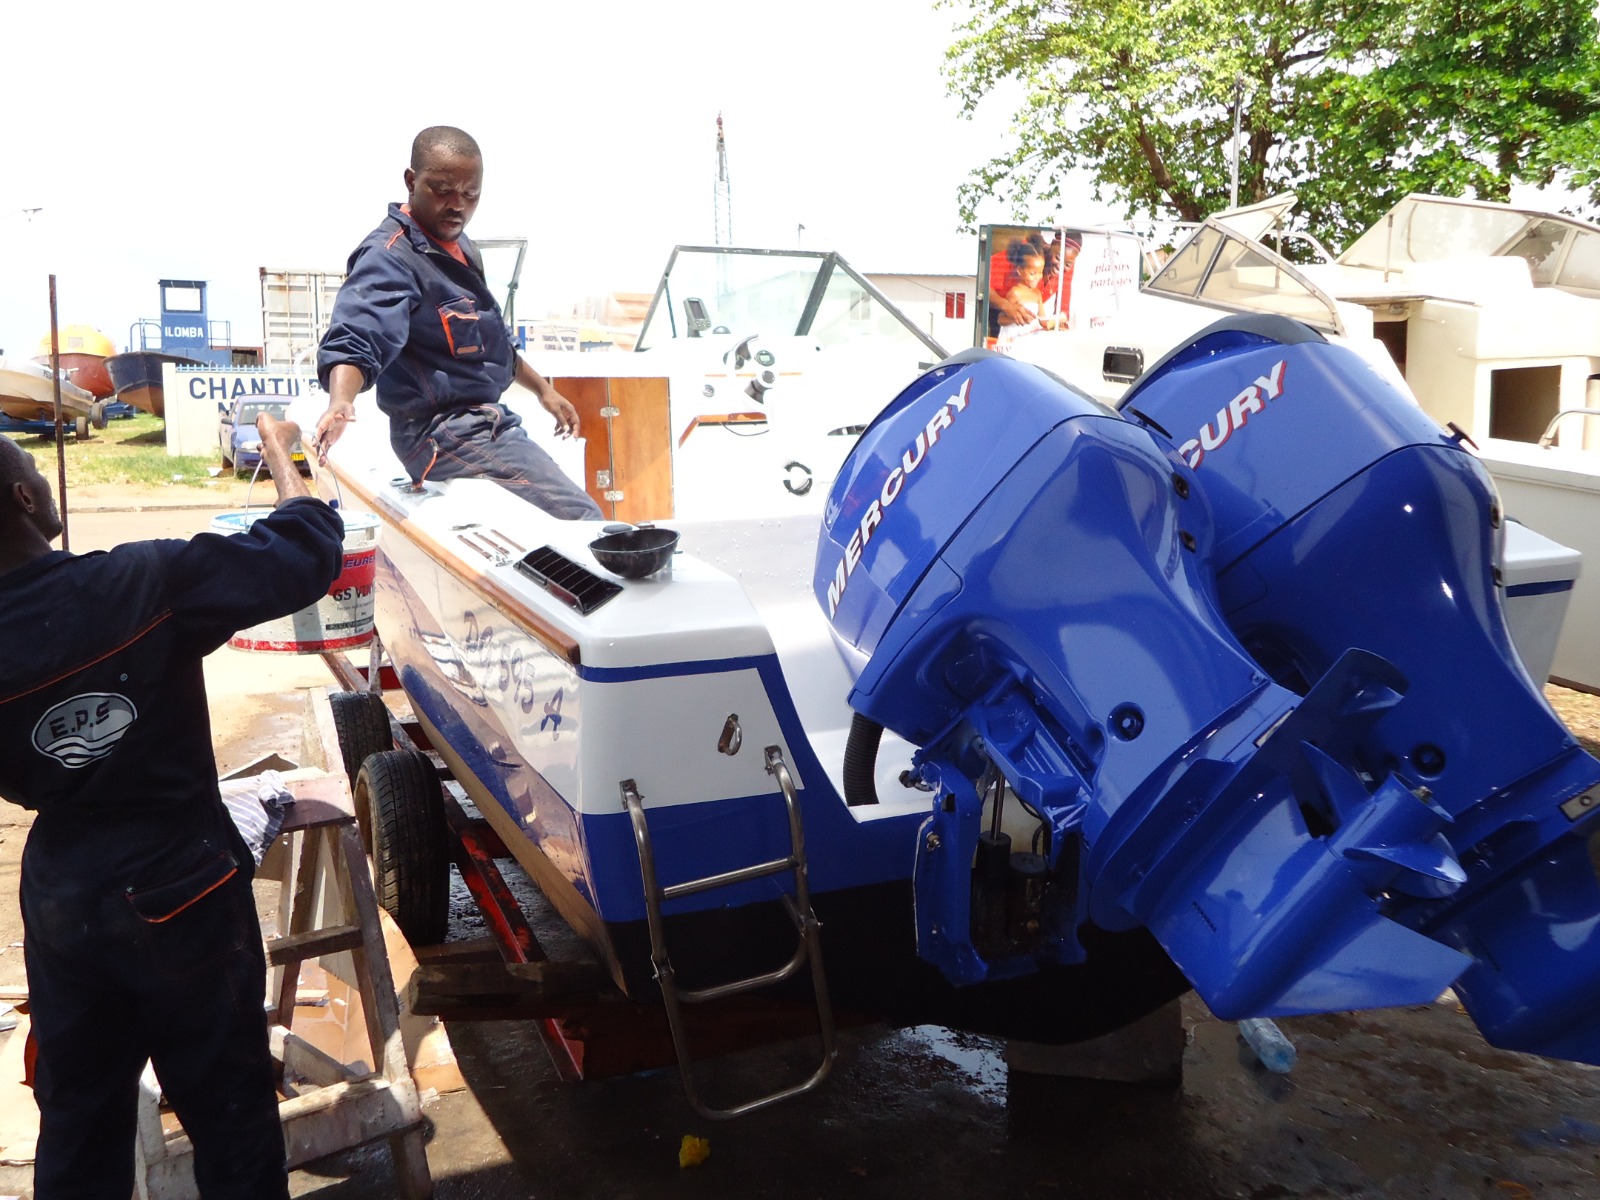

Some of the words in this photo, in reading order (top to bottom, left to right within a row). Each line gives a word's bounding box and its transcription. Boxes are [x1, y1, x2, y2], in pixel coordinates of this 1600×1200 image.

[1095, 263, 1130, 275] plasirs
[164, 326, 204, 338] ILOMBA
[189, 377, 322, 400] CHANTI
[827, 377, 973, 621] MERCURY
[333, 587, 352, 602] GS
[541, 687, 565, 741] A
